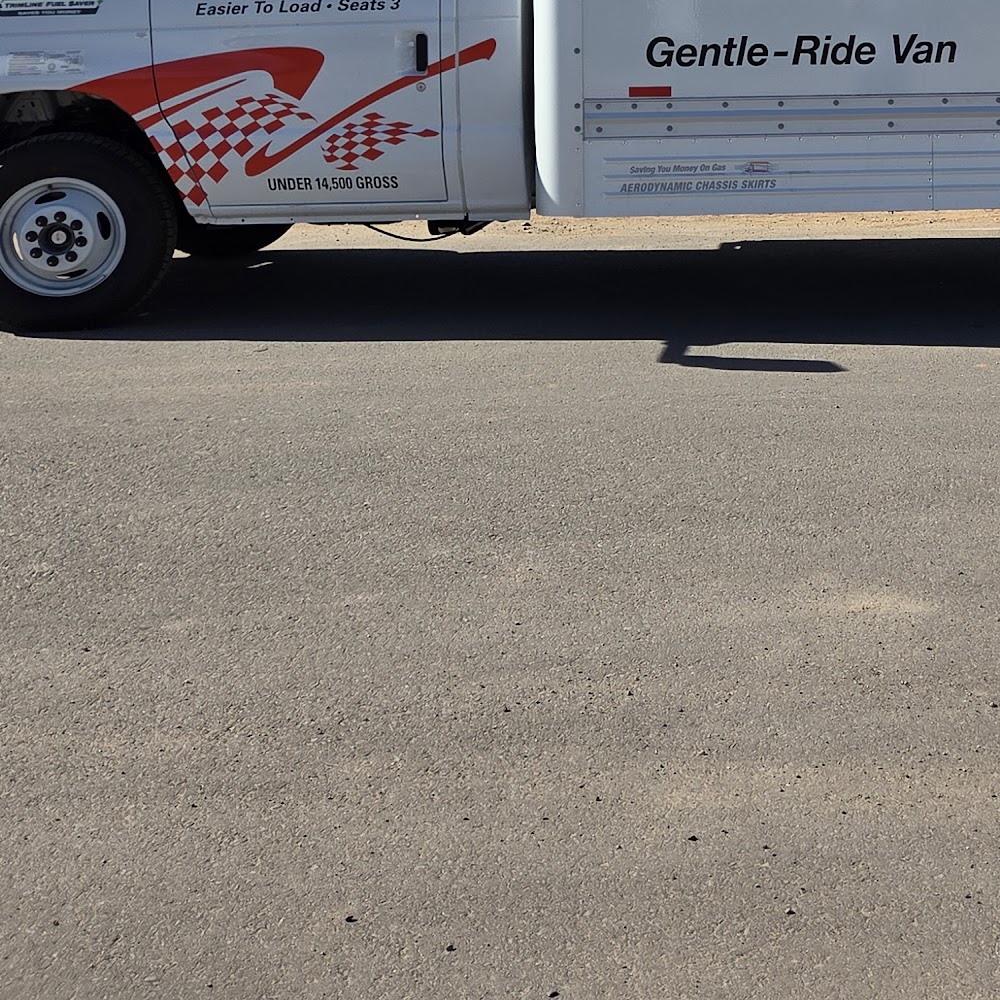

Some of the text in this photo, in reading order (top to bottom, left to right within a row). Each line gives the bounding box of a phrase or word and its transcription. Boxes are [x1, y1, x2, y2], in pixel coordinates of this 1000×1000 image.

[196, 2, 248, 16] Easier
[254, 0, 273, 14] To
[279, 0, 321, 13] Load
[646, 34, 957, 67] Gentle-Ride Van
[657, 165, 671, 173] You
[673, 164, 698, 174] Money
[700, 164, 709, 172] On
[712, 163, 726, 171] Gas
[267, 176, 399, 191] UNDER 14,500 GROSS
[620, 179, 777, 193] AERODYNAMIC CHASSIS SKIRTS
